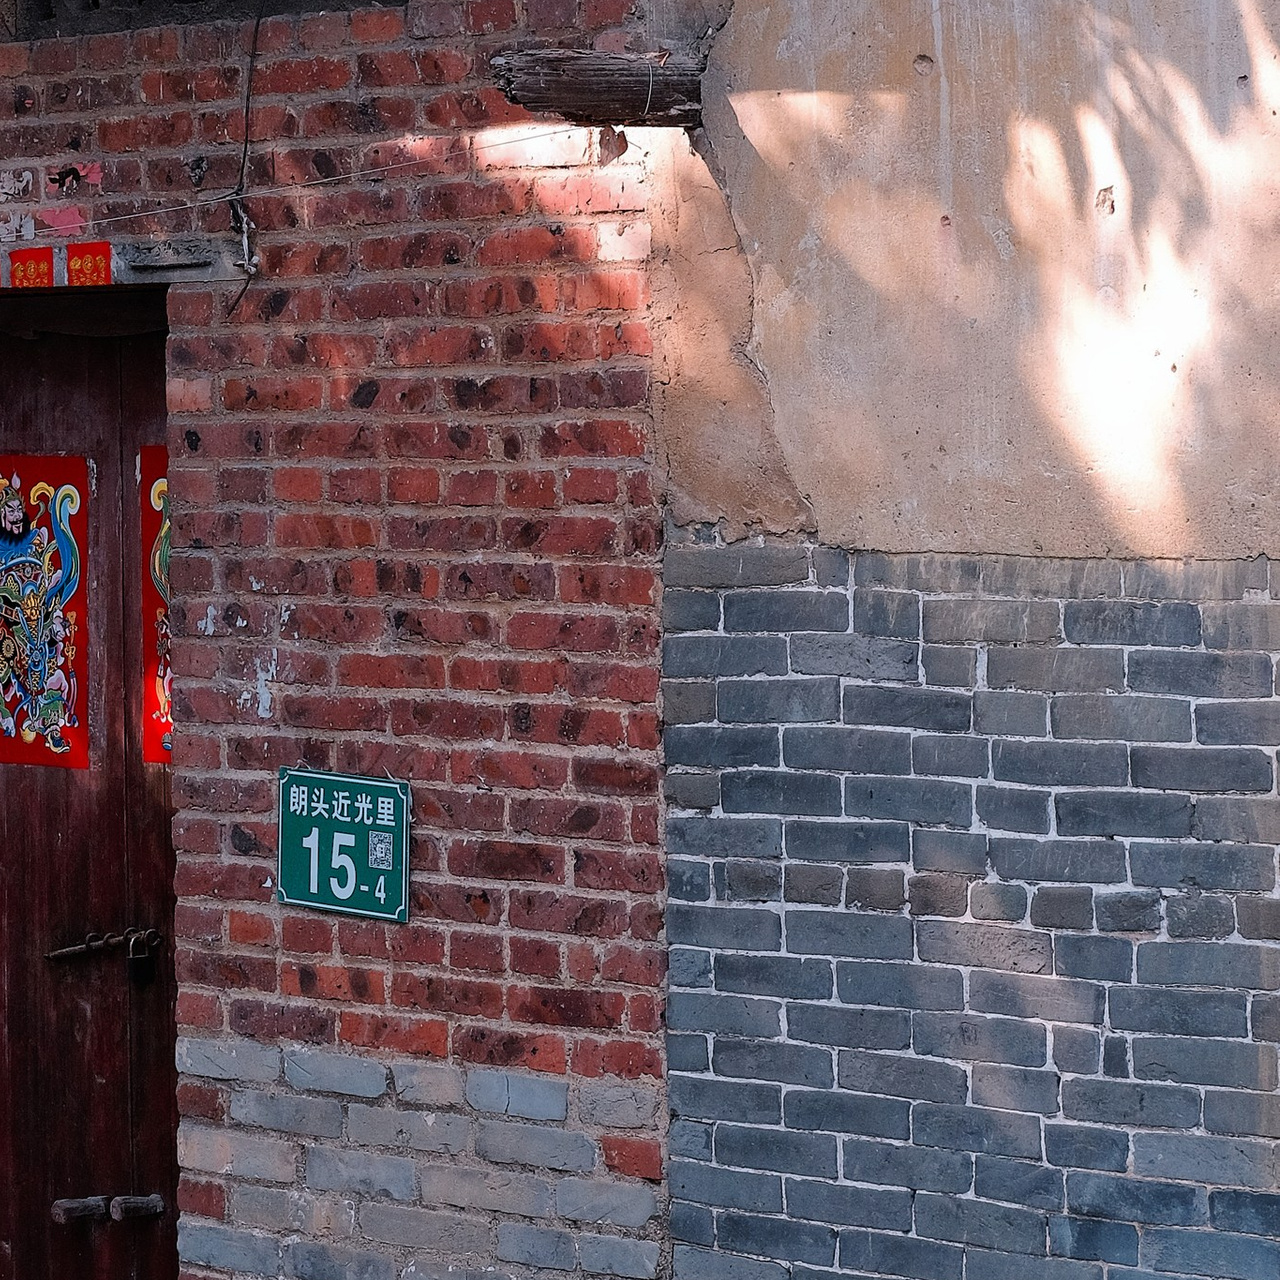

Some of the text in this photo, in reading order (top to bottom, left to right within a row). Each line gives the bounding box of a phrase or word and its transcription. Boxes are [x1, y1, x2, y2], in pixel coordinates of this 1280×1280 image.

[289, 783, 396, 827] 朗头近光里
